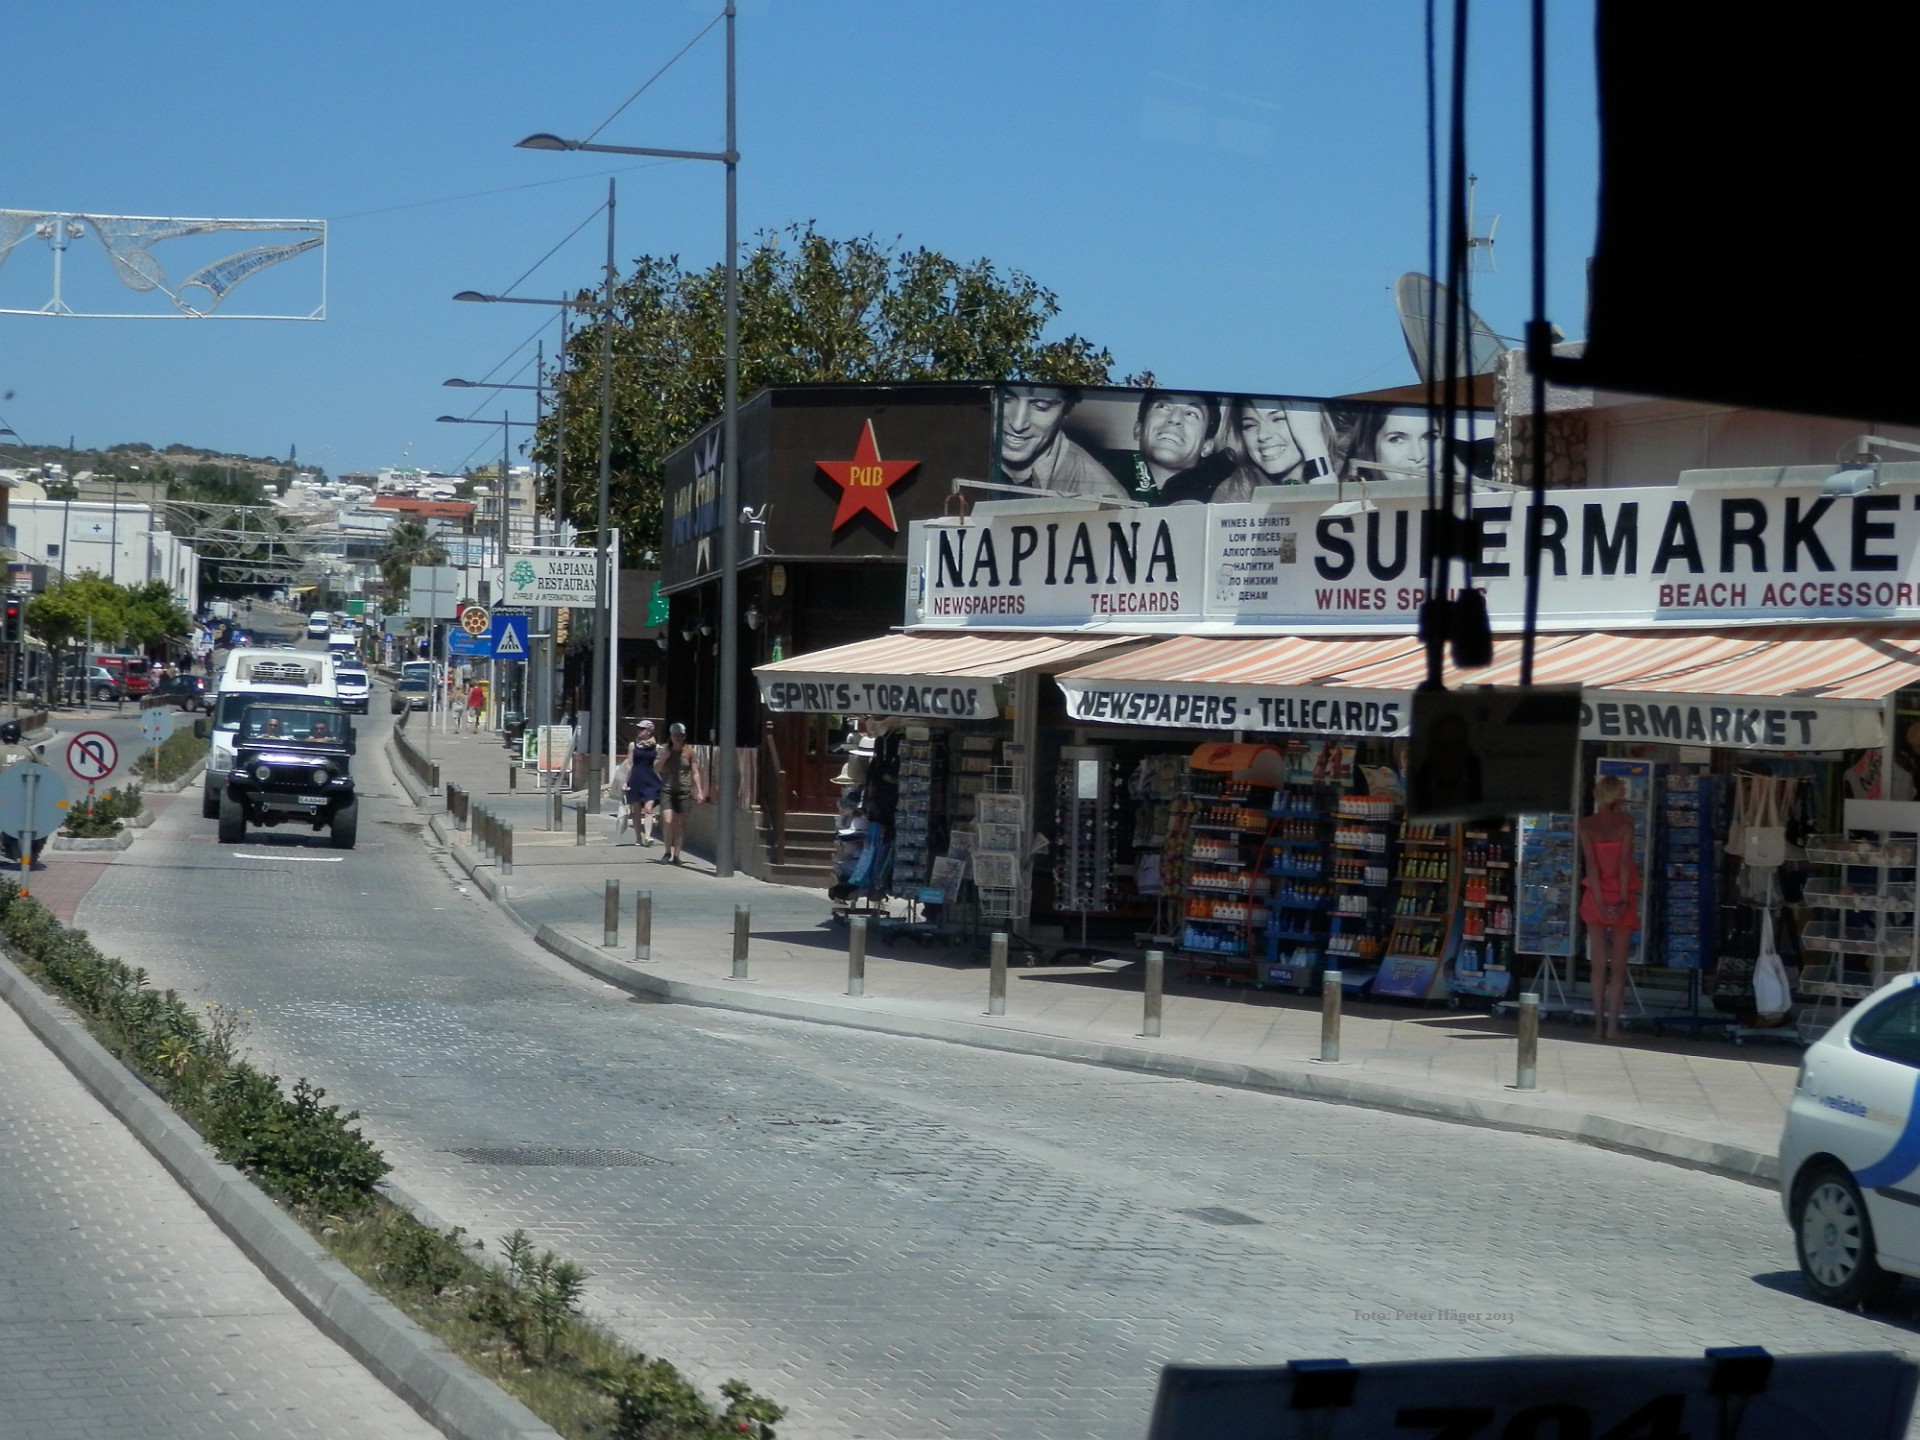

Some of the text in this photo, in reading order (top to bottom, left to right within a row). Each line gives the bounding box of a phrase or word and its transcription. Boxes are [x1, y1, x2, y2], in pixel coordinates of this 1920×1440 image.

[850, 466, 883, 487] PUB
[1221, 517, 1291, 528] WINES & SPIRITS
[1229, 532, 1281, 542] LOW PRICES
[1314, 494, 1920, 582] SUERMARKE
[935, 519, 1178, 587] NAPIANA
[1223, 547, 1281, 557] АЛКОГОЛЬНЫ
[549, 562, 595, 576] NAPIANA
[538, 577, 597, 591] RESTAURAN
[1243, 576, 1278, 586] НИЗКИМ
[512, 592, 533, 600] CYPRUS
[934, 591, 1180, 615] NEWSPAPERS TELECARDS
[1315, 588, 1386, 610] WINES
[1659, 582, 1747, 607] BEACH
[1077, 690, 1399, 733] NEWSPAPERS TELECARDS
[1580, 702, 1818, 745] PERMARKET
[1270, 969, 1292, 980] NIVEA
